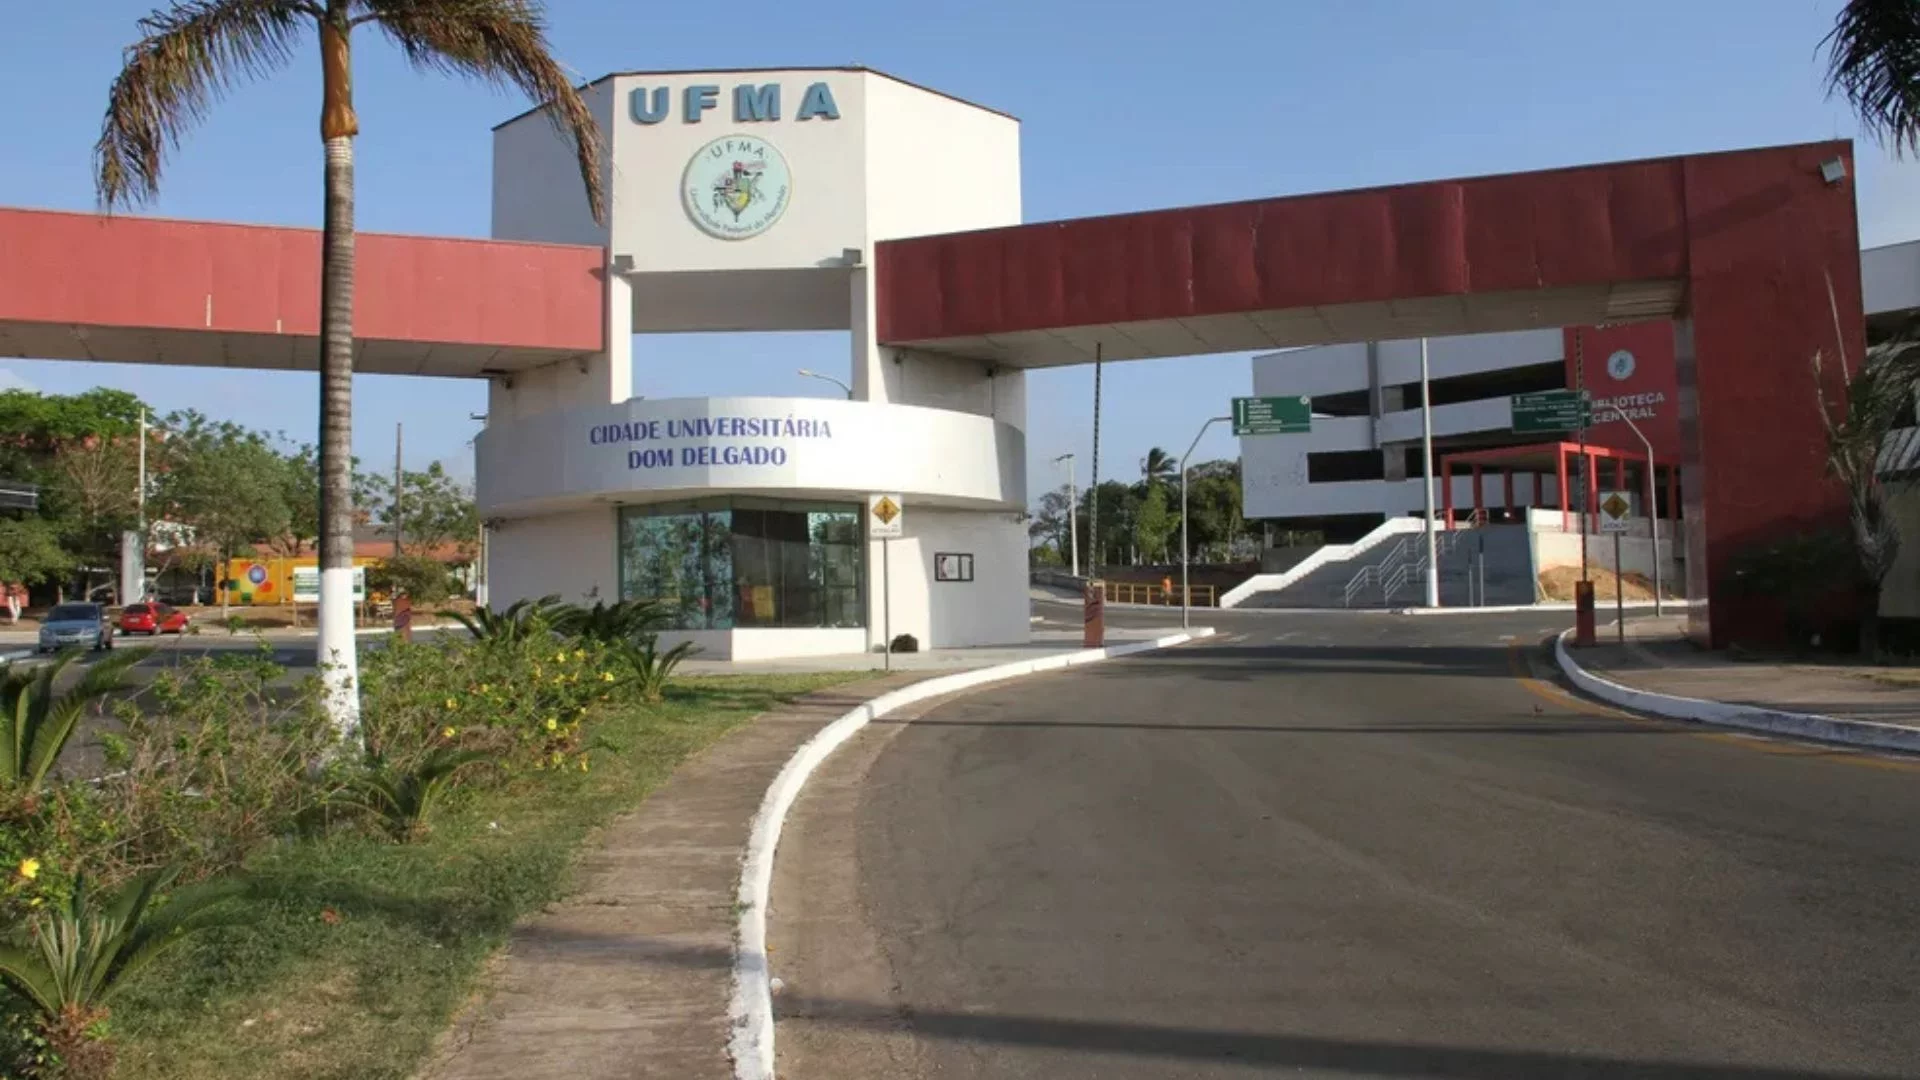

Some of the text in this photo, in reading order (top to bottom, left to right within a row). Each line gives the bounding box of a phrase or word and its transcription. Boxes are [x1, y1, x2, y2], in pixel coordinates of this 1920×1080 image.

[628, 81, 841, 126] UFMA
[710, 140, 765, 159] UFMA
[1591, 392, 1665, 409] IBLIOTECA
[1592, 406, 1657, 424] CENTRAL
[590, 414, 833, 445] CIDADE UNIVERSITÁRIA
[628, 446, 787, 470] DOM DELGADO
